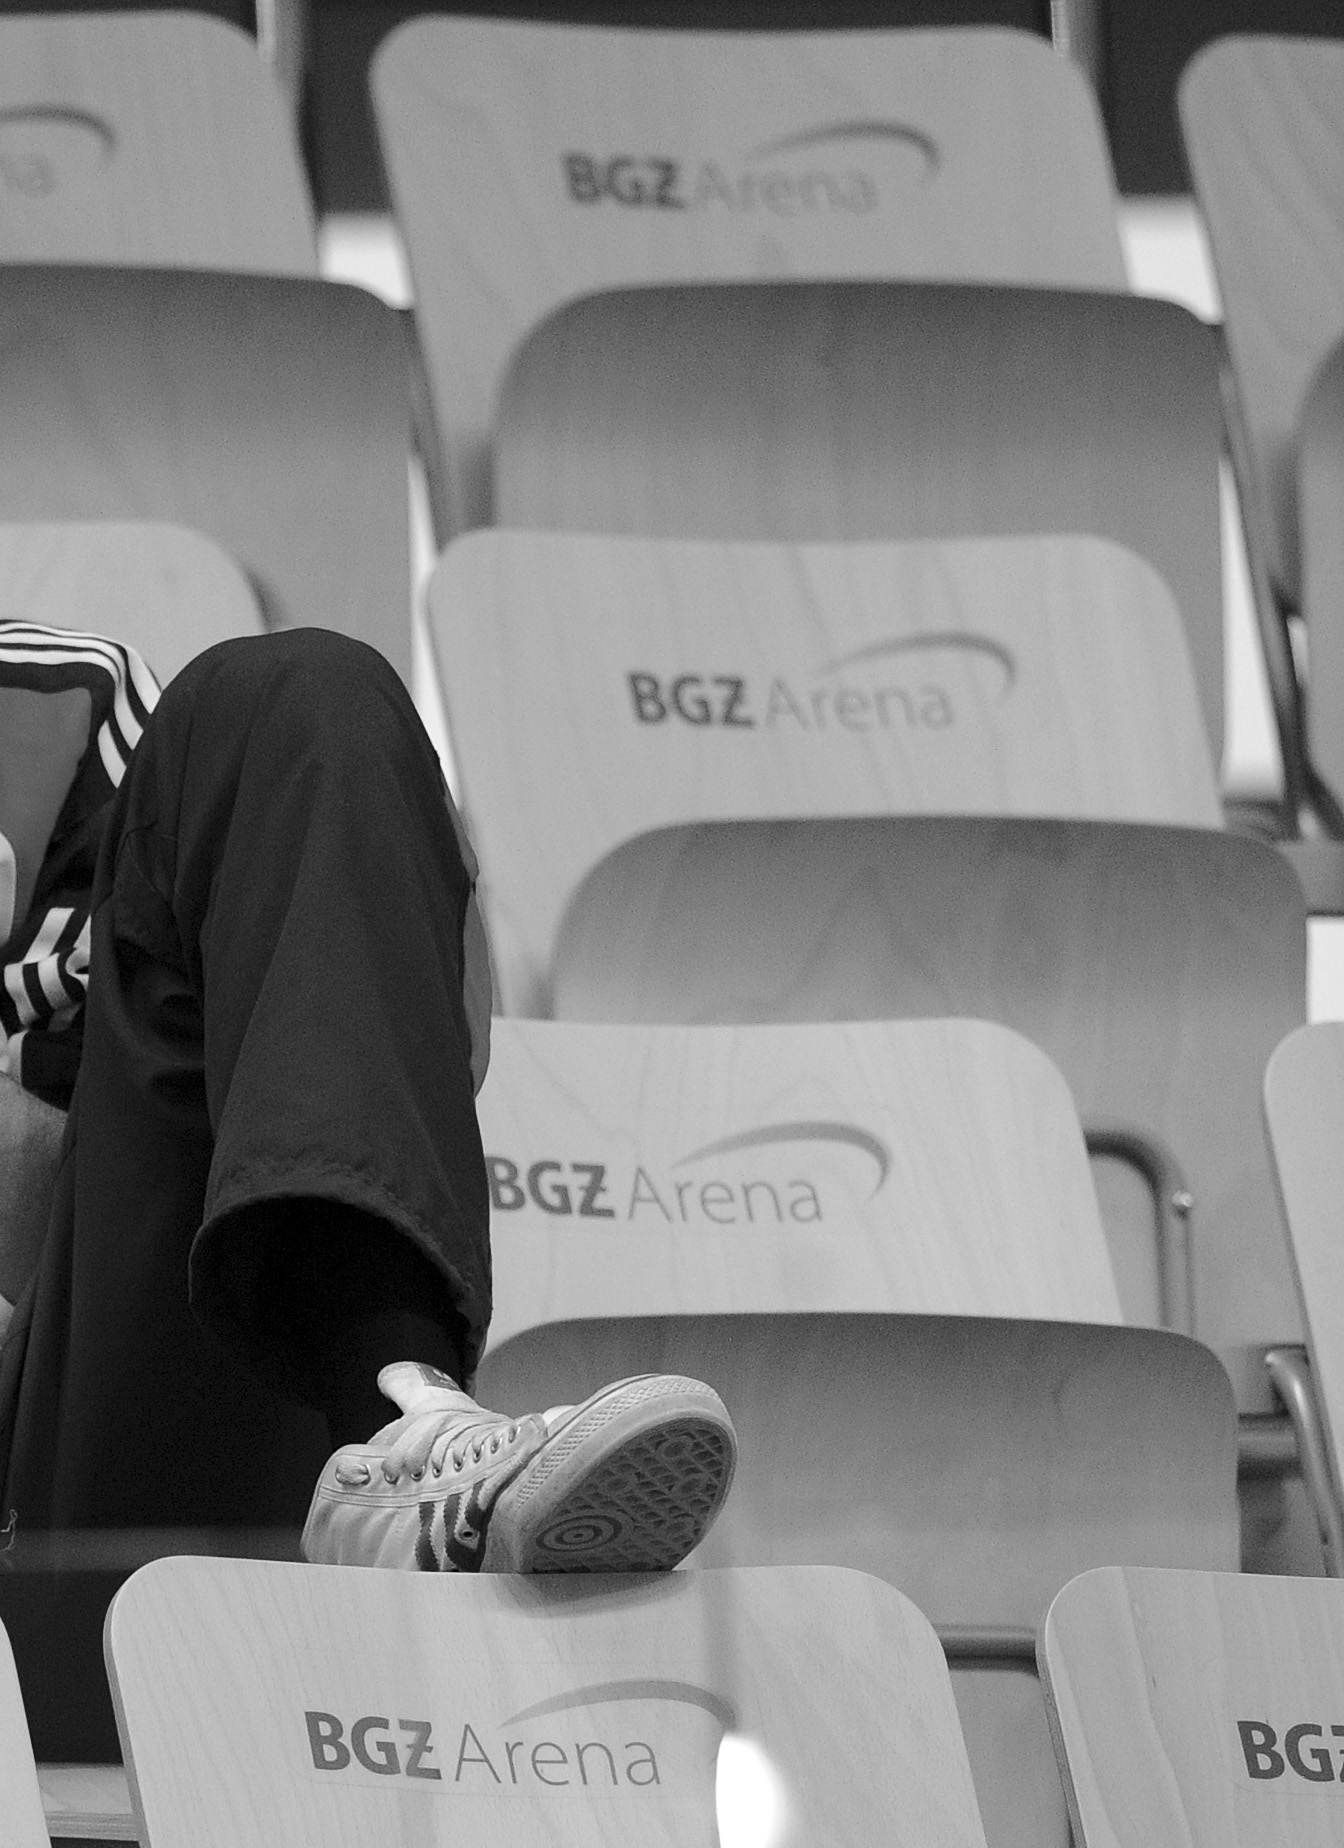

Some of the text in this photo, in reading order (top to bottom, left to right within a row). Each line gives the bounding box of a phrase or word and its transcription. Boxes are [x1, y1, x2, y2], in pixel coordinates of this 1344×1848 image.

[693, 160, 878, 216] Arena
[765, 677, 954, 732] Arena
[628, 1166, 823, 1224] Arena
[455, 1723, 661, 1786] Arena
